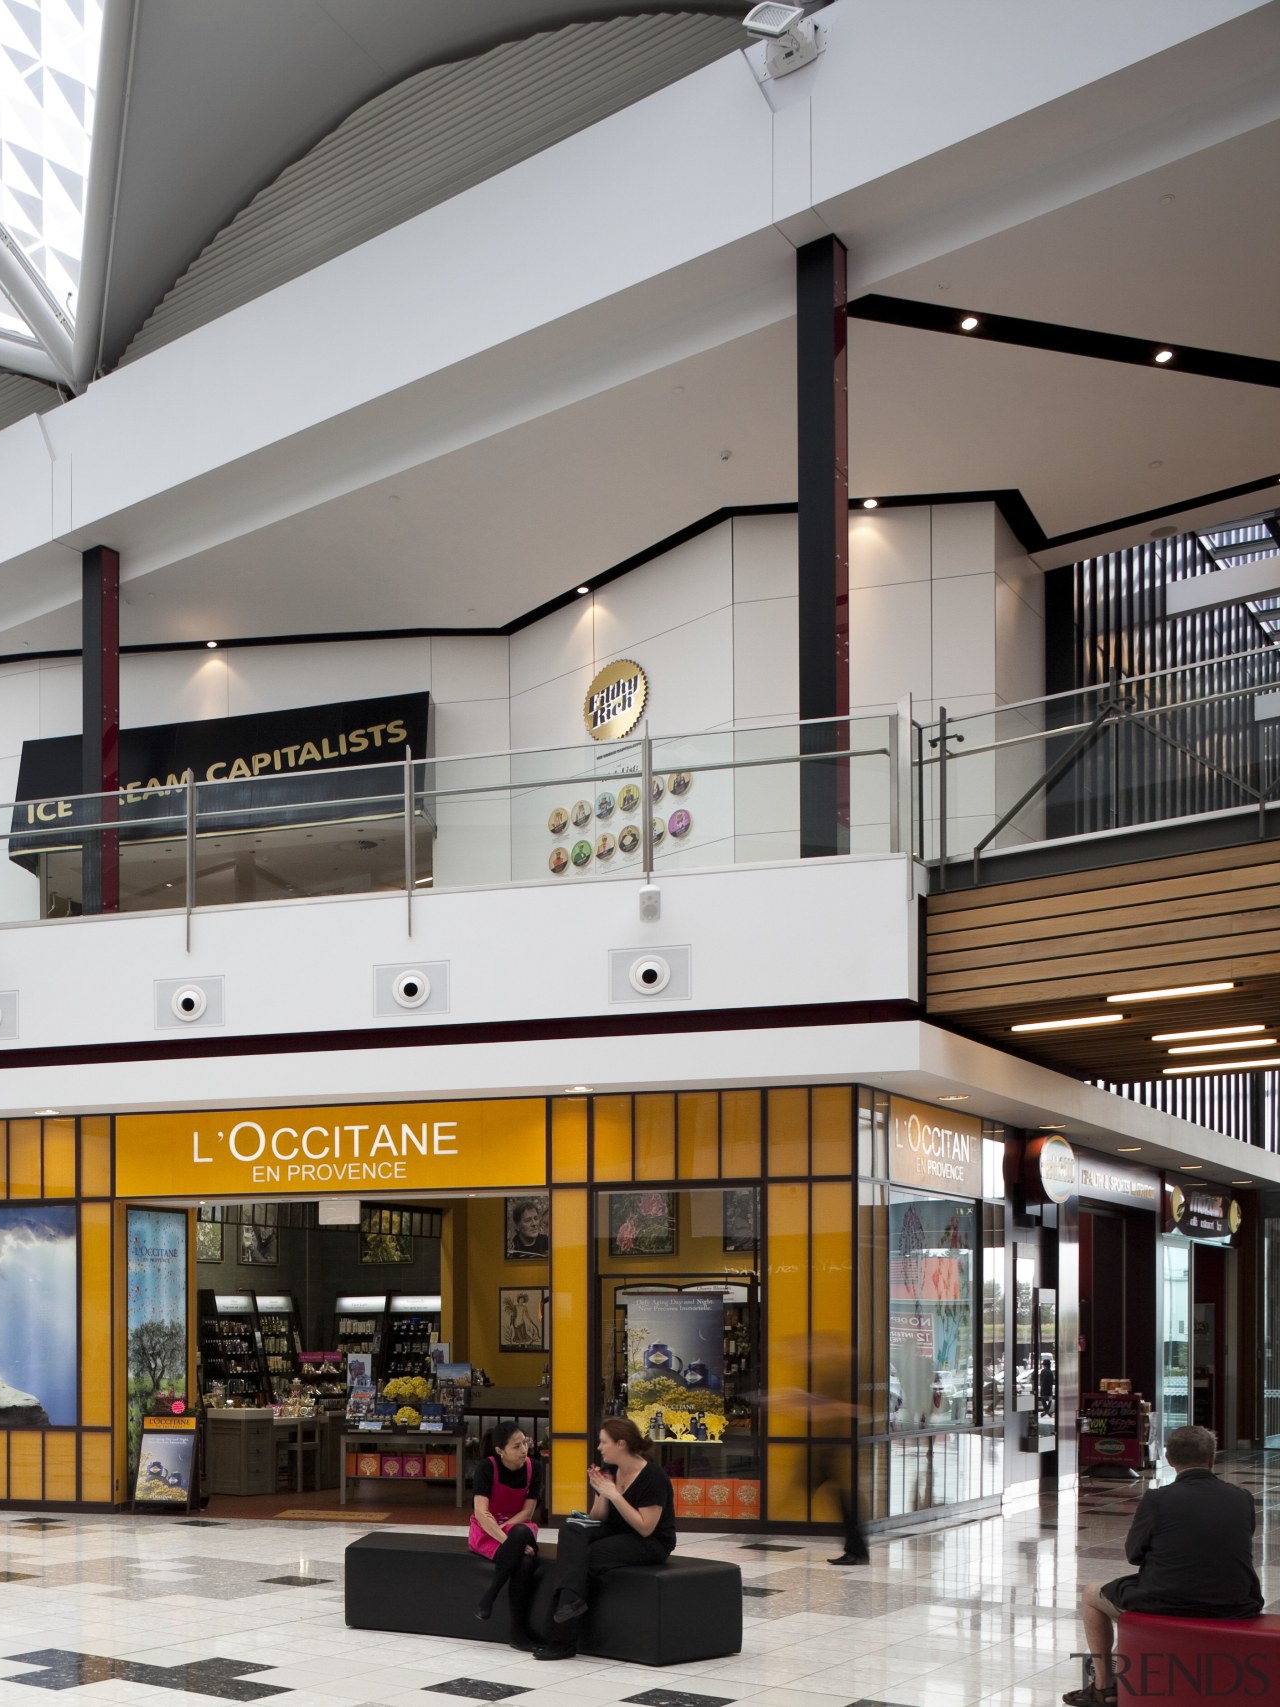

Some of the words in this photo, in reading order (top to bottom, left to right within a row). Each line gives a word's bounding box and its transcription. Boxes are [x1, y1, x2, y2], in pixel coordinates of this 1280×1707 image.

[588, 674, 639, 715] Filthy
[593, 691, 633, 729] Rich
[27, 801, 73, 824] ICE
[206, 719, 408, 783] CAPITALISTS
[193, 1121, 459, 1163] L'OCCITANE
[252, 1165, 280, 1183] EN
[287, 1161, 407, 1181] PROVENCE
[927, 1160, 964, 1181] PROVENCE
